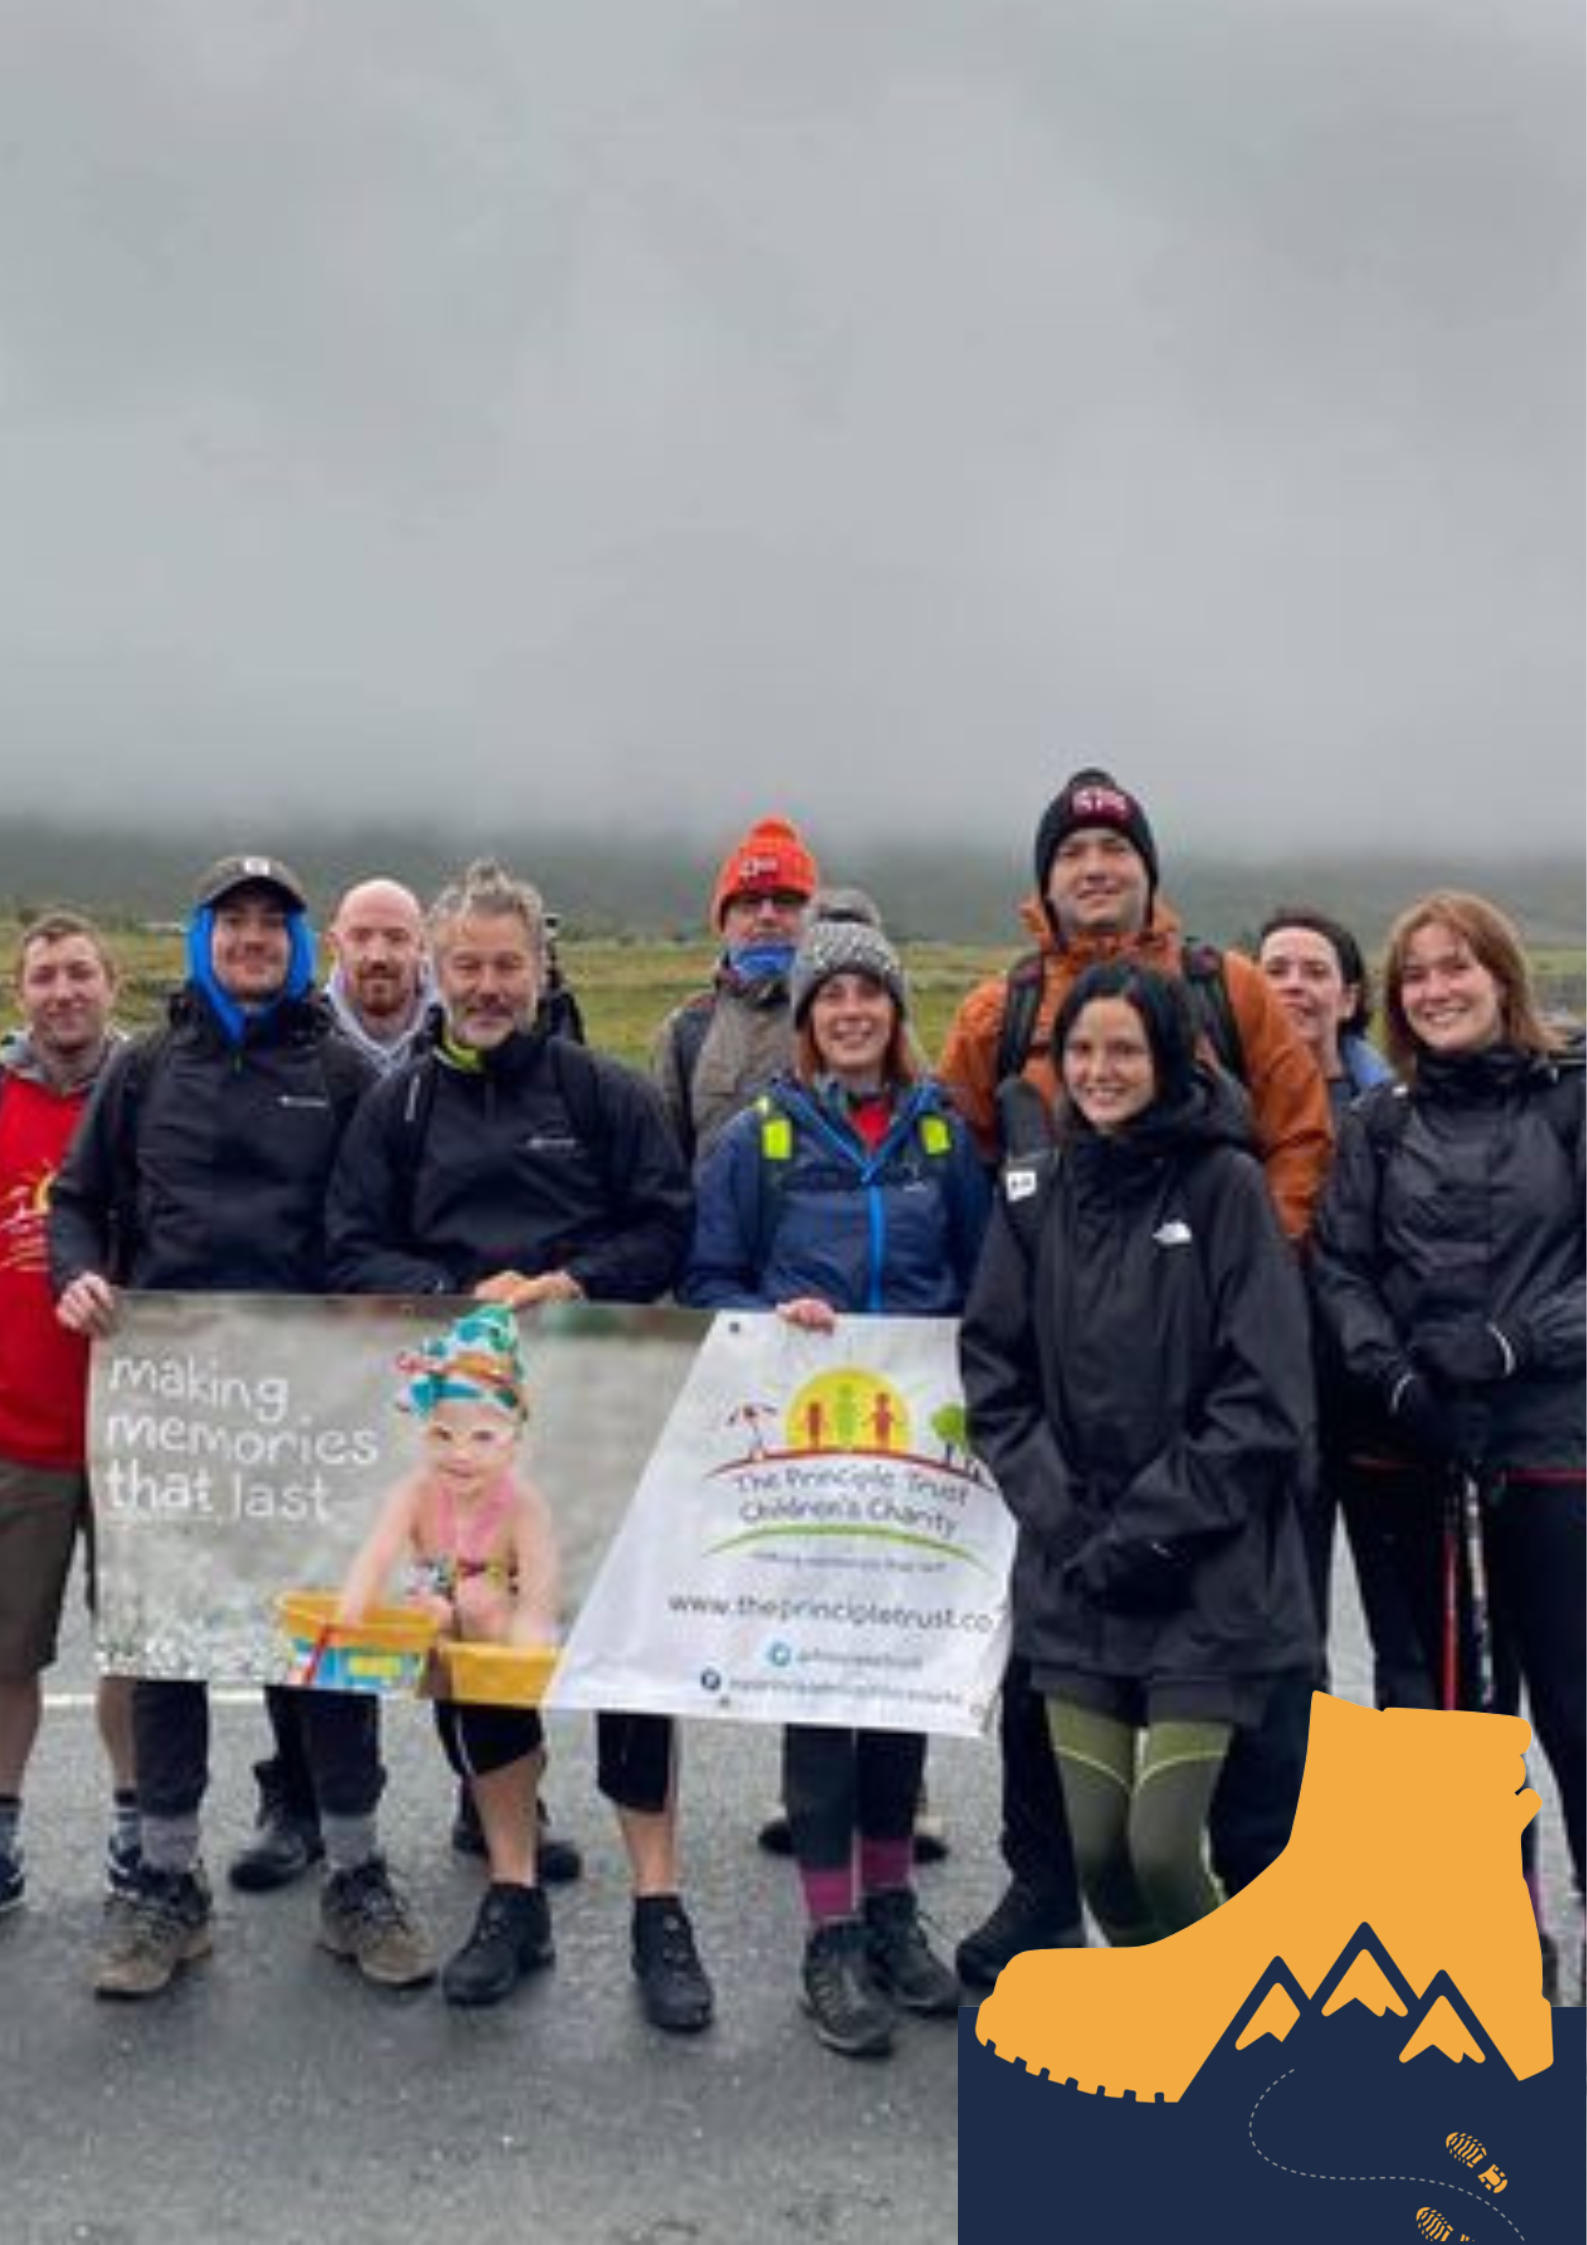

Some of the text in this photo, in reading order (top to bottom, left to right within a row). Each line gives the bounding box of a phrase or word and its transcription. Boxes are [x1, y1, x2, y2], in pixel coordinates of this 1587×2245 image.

[108, 1354, 289, 1423] making
[105, 1411, 378, 1465] memories
[106, 1457, 332, 1522] that last
